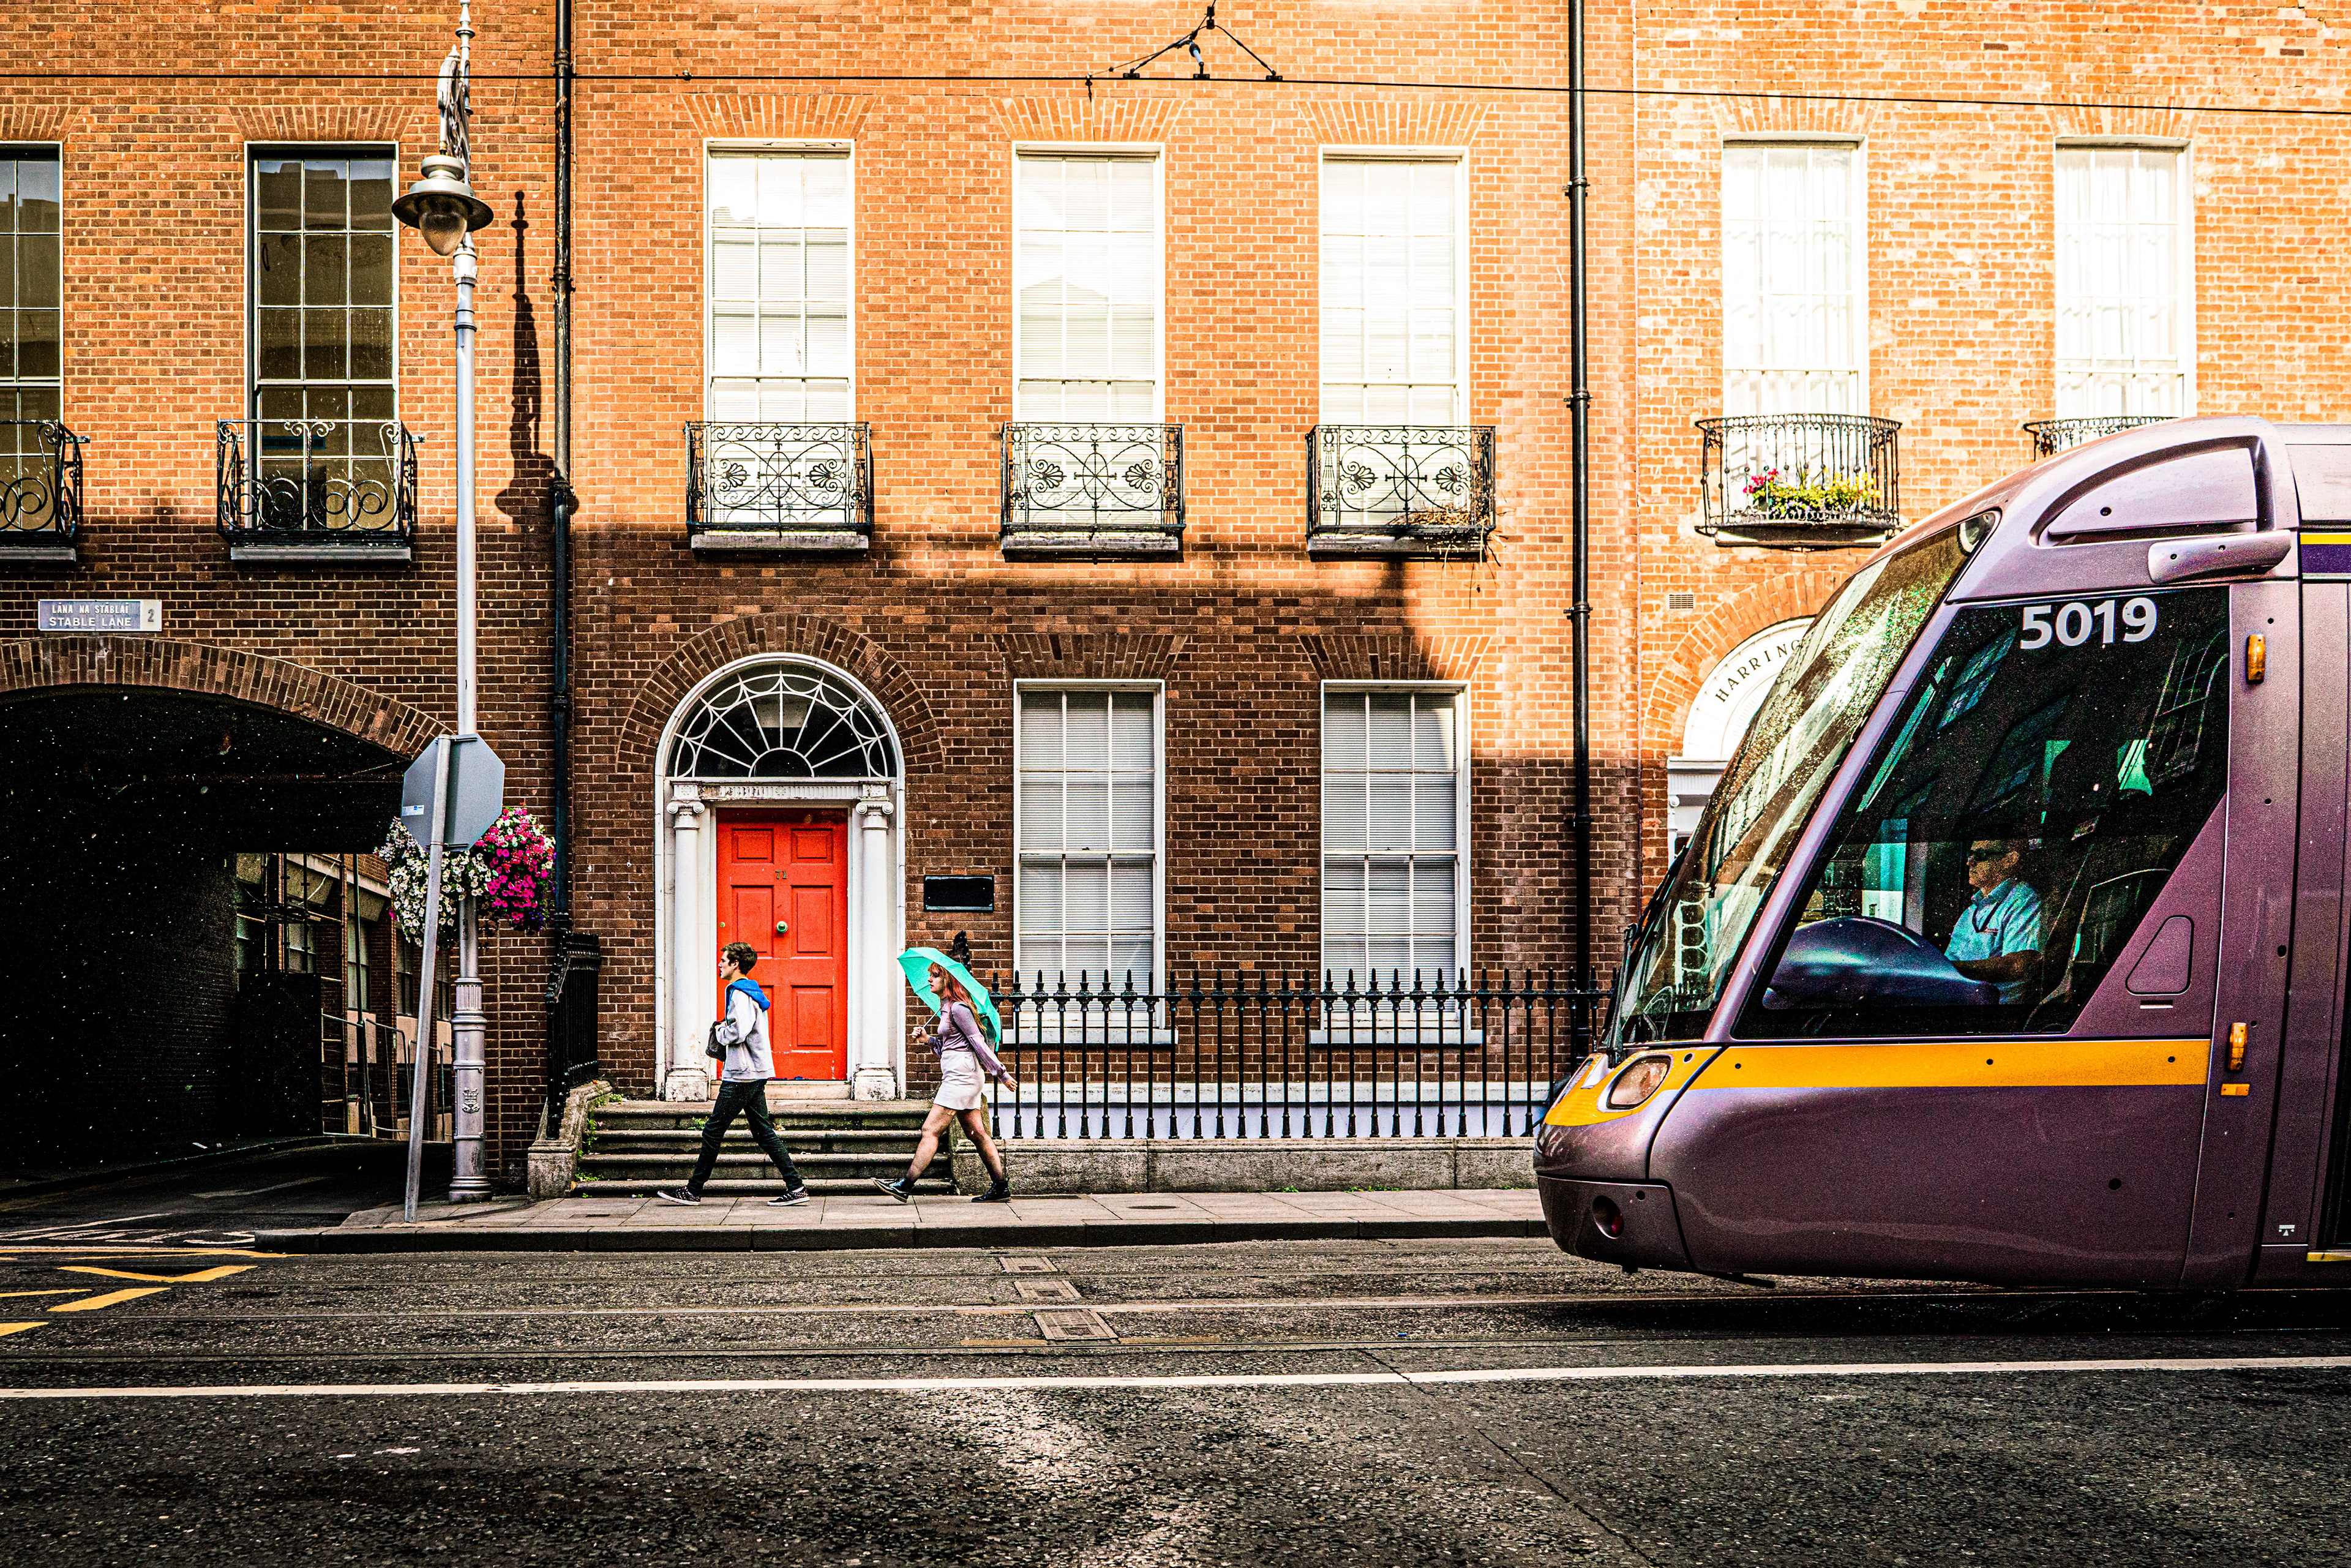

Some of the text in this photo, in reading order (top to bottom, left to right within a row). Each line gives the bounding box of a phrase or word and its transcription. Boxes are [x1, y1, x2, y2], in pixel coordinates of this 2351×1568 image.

[80, 604, 90, 614] NA
[148, 609, 154, 622] 2
[49, 617, 132, 627] STABLE LANE
[2020, 598, 2158, 649] 5019
[775, 870, 787, 880] 71
